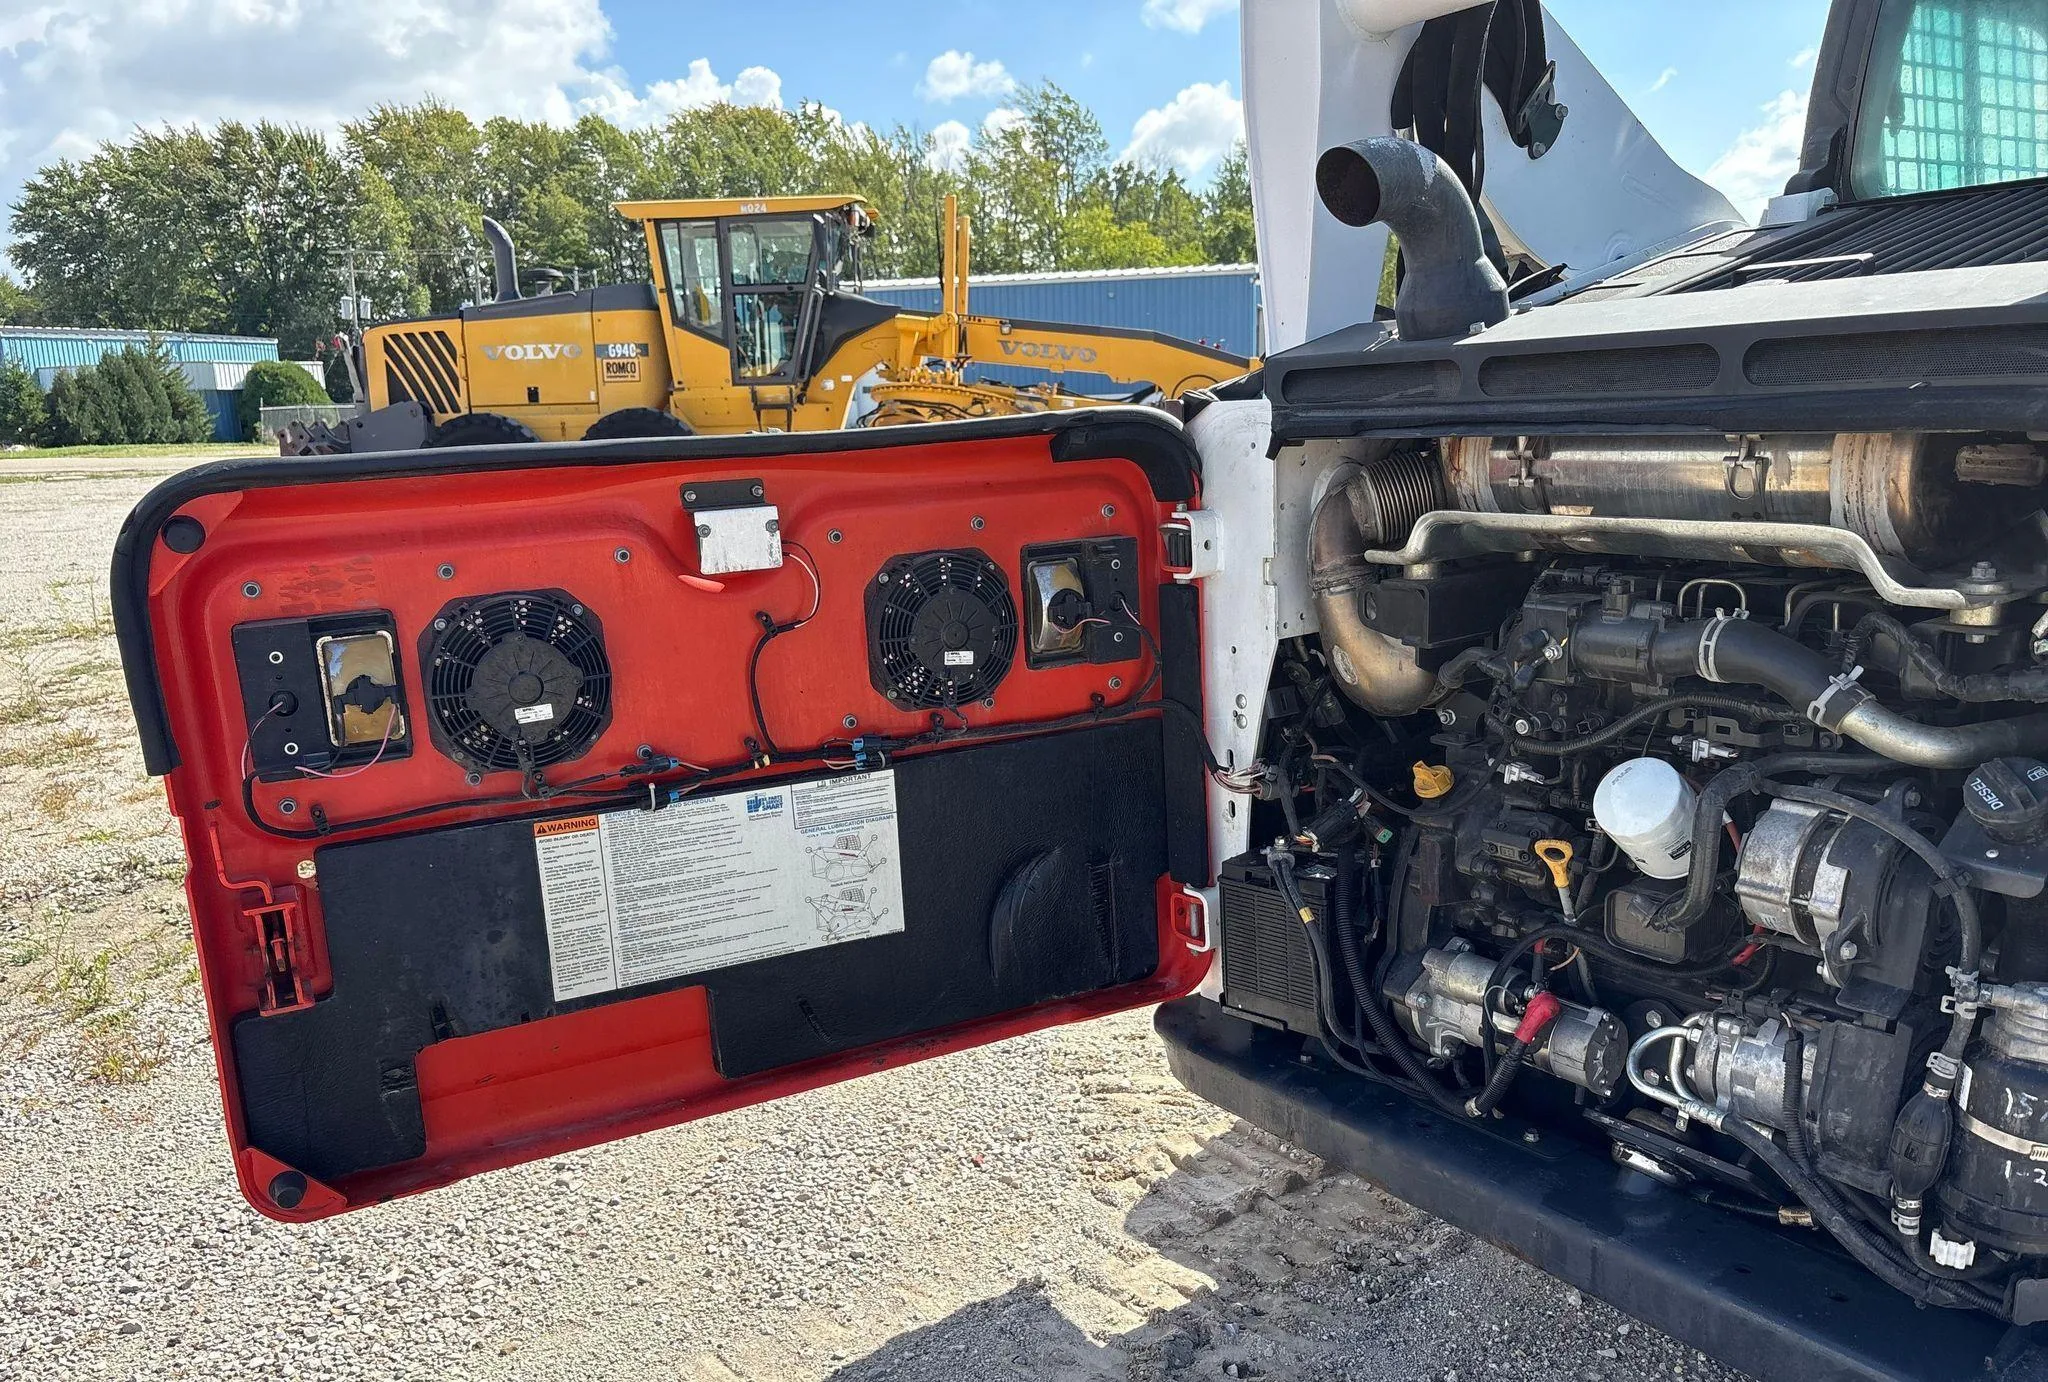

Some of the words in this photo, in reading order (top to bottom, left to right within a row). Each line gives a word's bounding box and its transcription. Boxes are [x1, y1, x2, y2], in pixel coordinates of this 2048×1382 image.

[480, 344, 582, 360] VOLVO
[997, 340, 1097, 362] VOLVO
[606, 362, 636, 374] ROMCO
[829, 773, 871, 784] IMPORTANT
[1970, 777, 2004, 811] DIESEL
[604, 810, 631, 818] SERVICE
[683, 797, 716, 806] SCHEDULE
[761, 802, 783, 810] SMART
[547, 819, 596, 832] WARNING
[800, 825, 827, 834] GENERAL
[827, 819, 864, 829] LUBRICATION
[865, 814, 893, 823] DIAGRAMS
